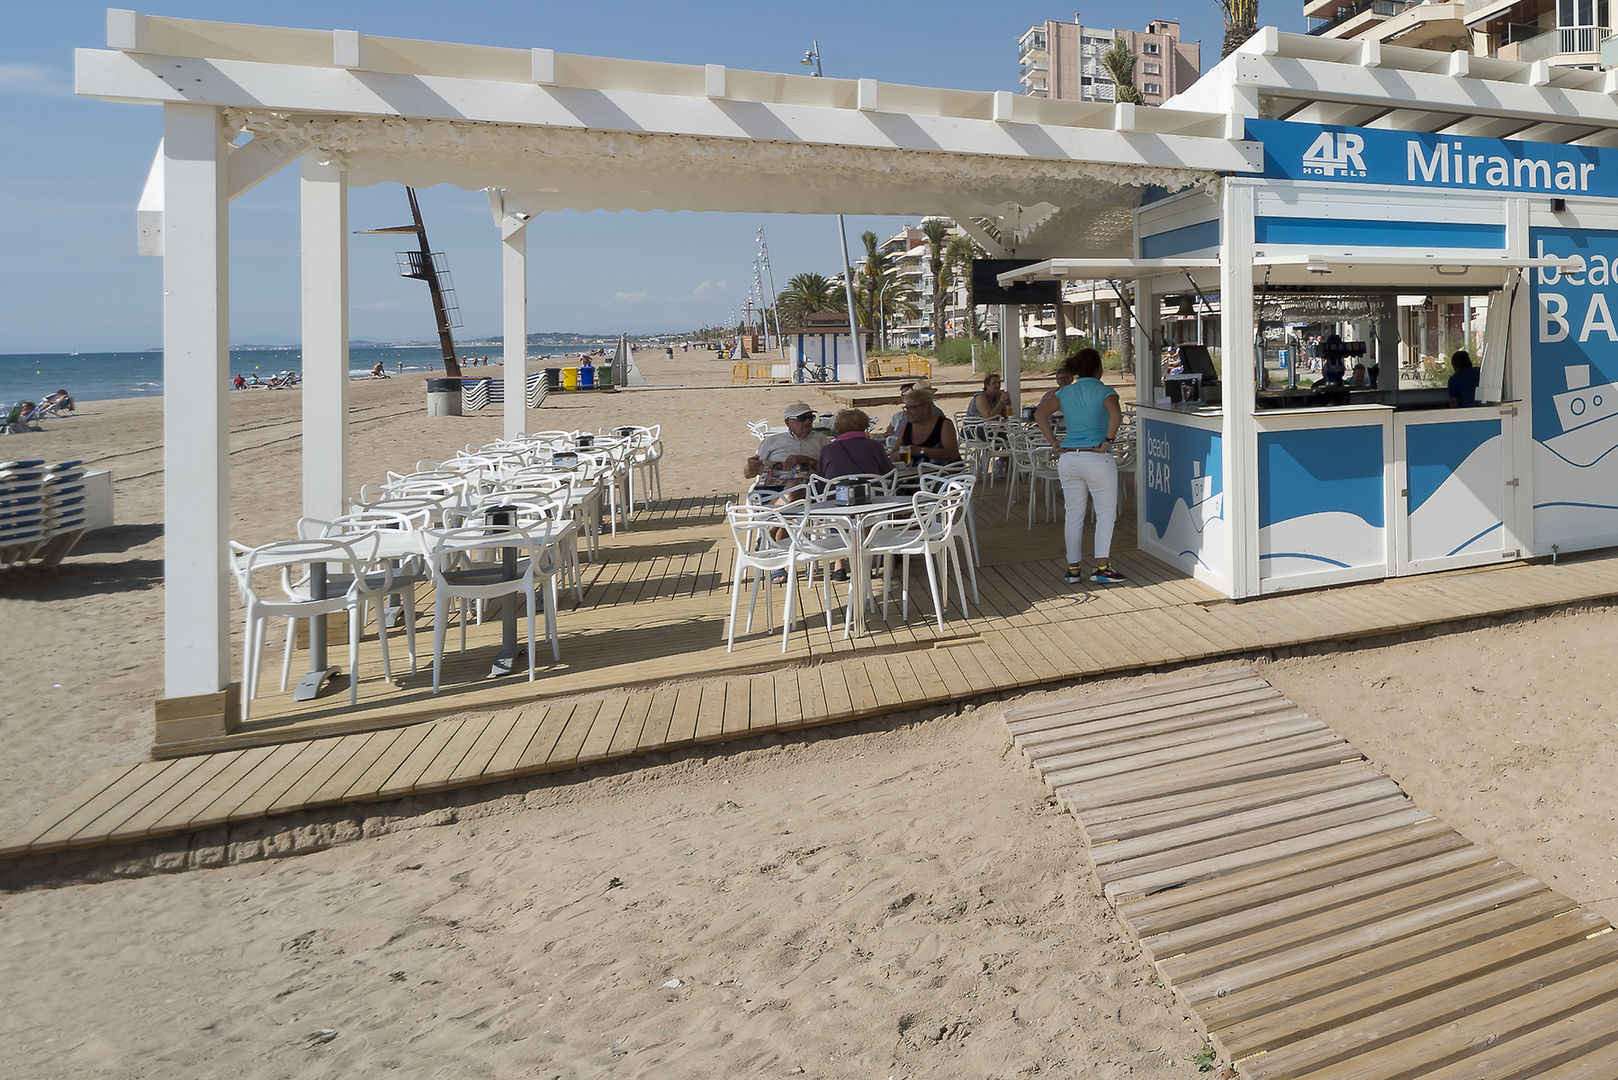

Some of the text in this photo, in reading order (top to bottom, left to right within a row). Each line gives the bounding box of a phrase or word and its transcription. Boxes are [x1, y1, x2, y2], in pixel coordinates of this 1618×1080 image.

[1303, 131, 1367, 176] 4R
[1406, 140, 1595, 191] Miramar
[1147, 429, 1170, 460] beach
[1147, 459, 1171, 494] BAR
